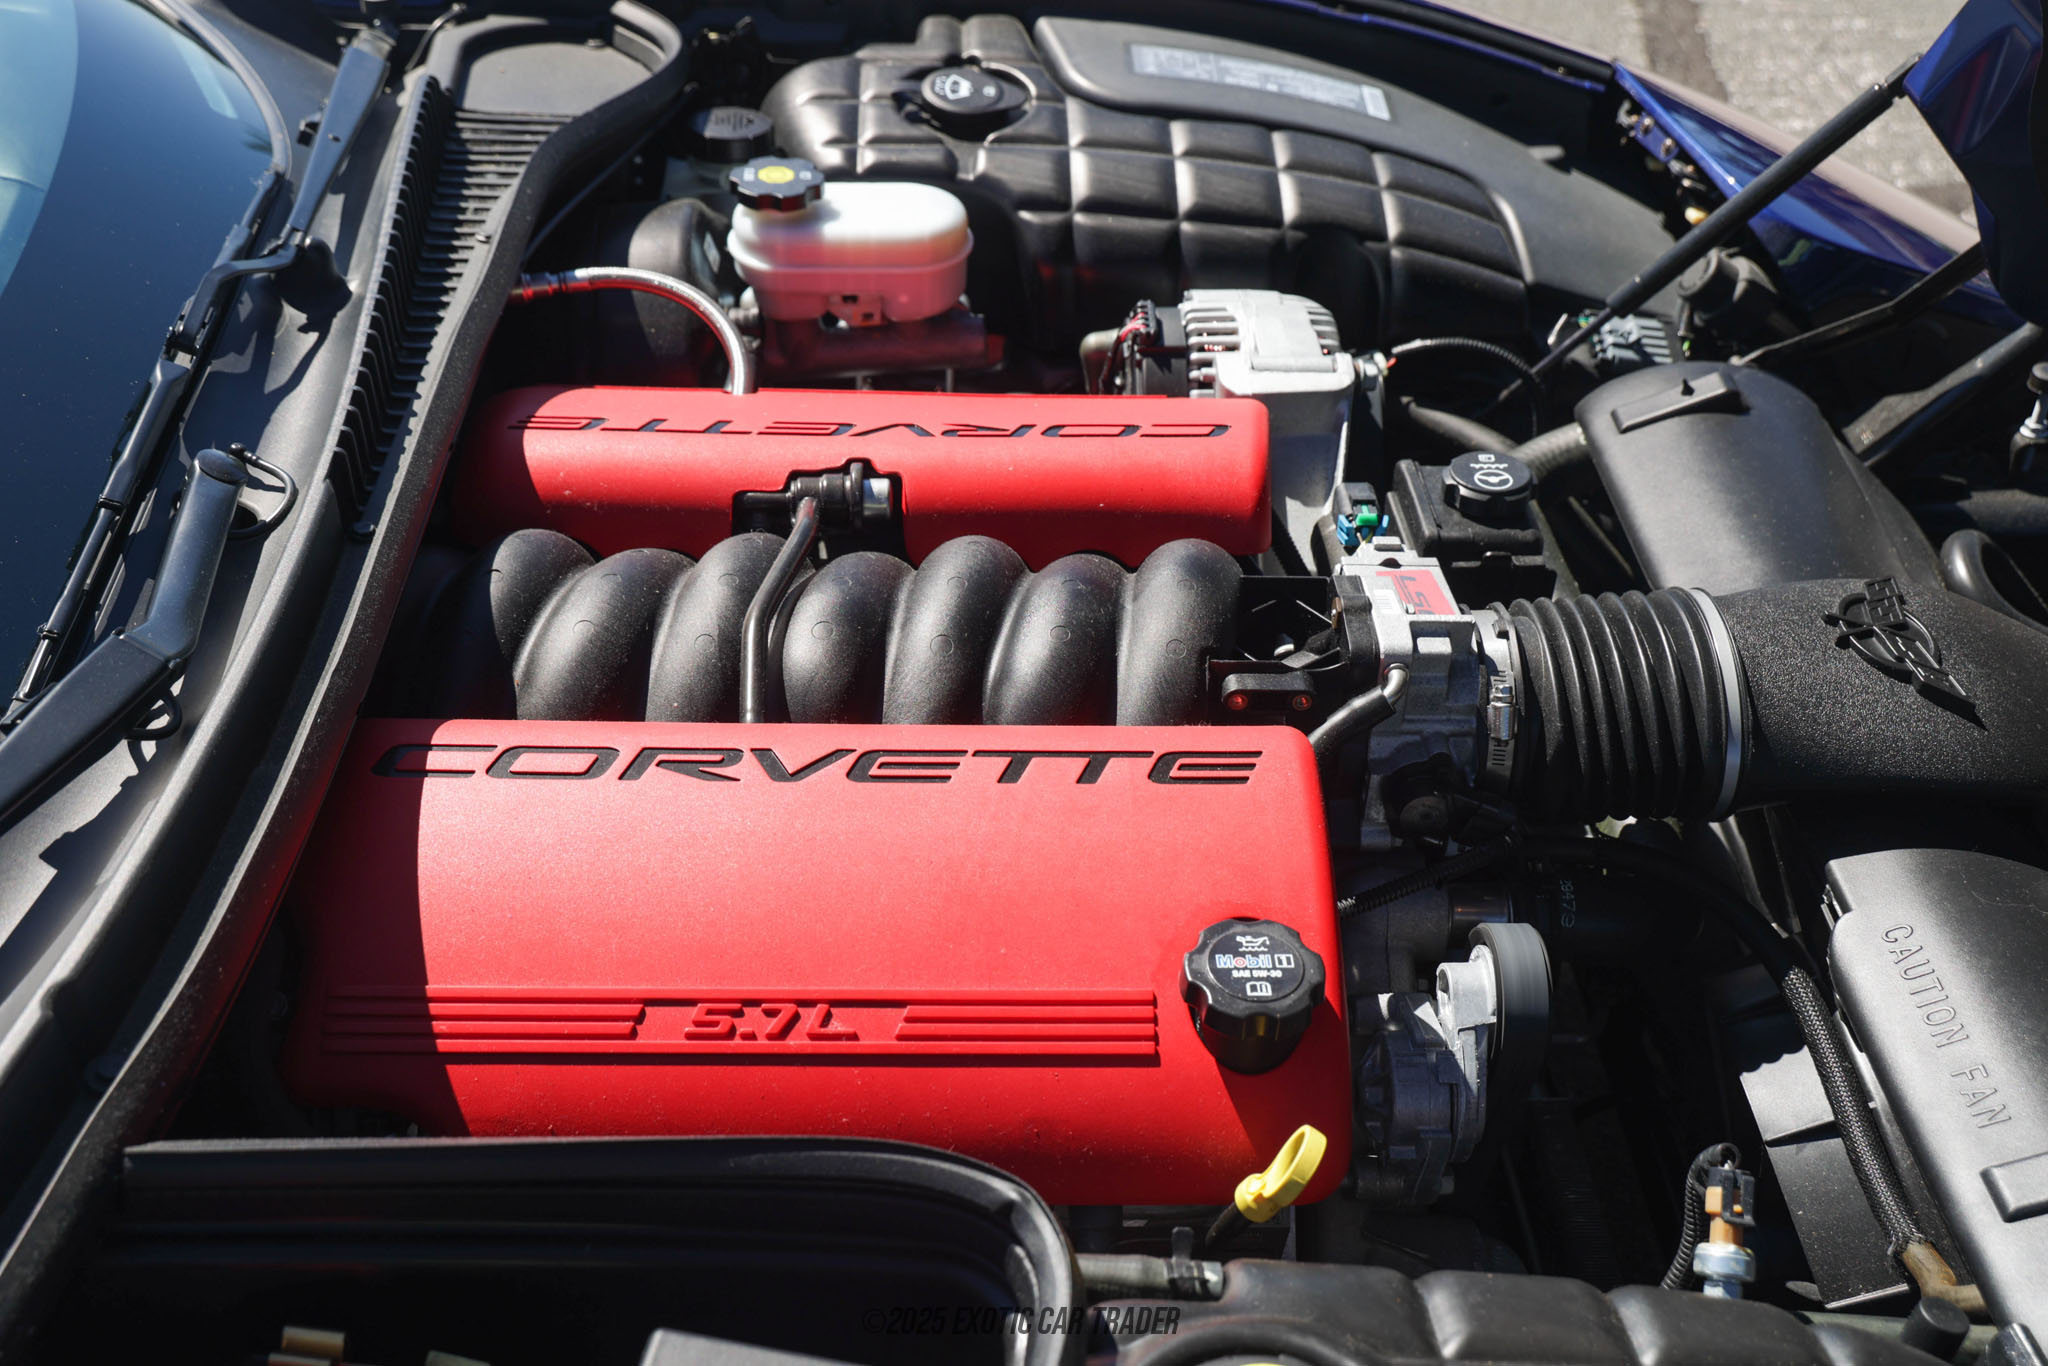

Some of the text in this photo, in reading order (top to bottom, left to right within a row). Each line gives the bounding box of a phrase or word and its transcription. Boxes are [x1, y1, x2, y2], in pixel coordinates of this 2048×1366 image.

[507, 415, 1232, 438] CORVETTE
[370, 743, 1264, 785] CORVETTE
[1215, 954, 1295, 968] Mobil 1
[1231, 970, 1283, 978] SAE 5W-30
[684, 1003, 860, 1042] 5.7L
[1881, 923, 2012, 1129] CAUTION FAN
